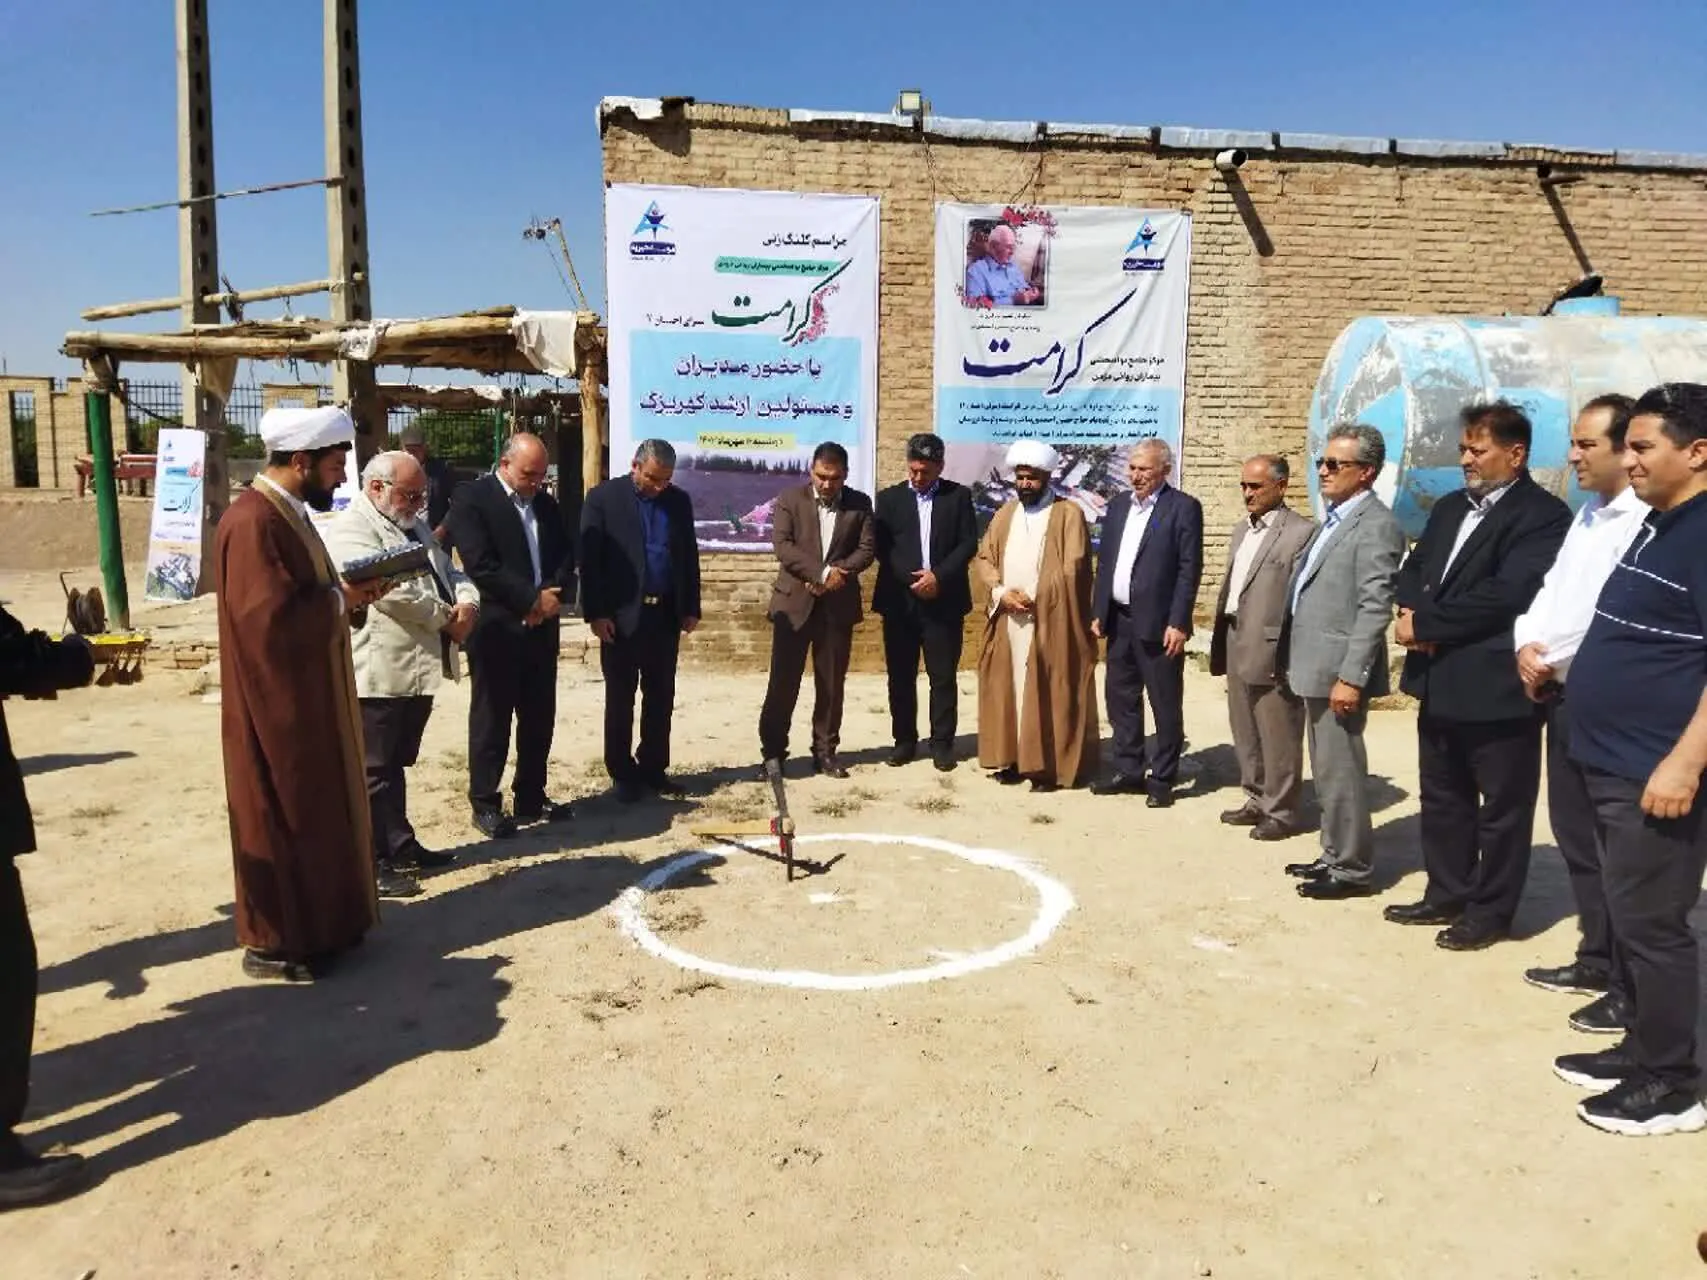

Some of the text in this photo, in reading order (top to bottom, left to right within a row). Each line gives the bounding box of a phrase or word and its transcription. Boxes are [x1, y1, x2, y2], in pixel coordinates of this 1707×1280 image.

[812, 233, 847, 249] مراسم
[711, 257, 854, 342] کرامت
[962, 288, 1138, 395] کرامت
[676, 354, 822, 379] با حضور مدیران
[639, 392, 706, 414] کهریزک
[708, 395, 750, 416] ارشد
[843, 403, 853, 418] و
